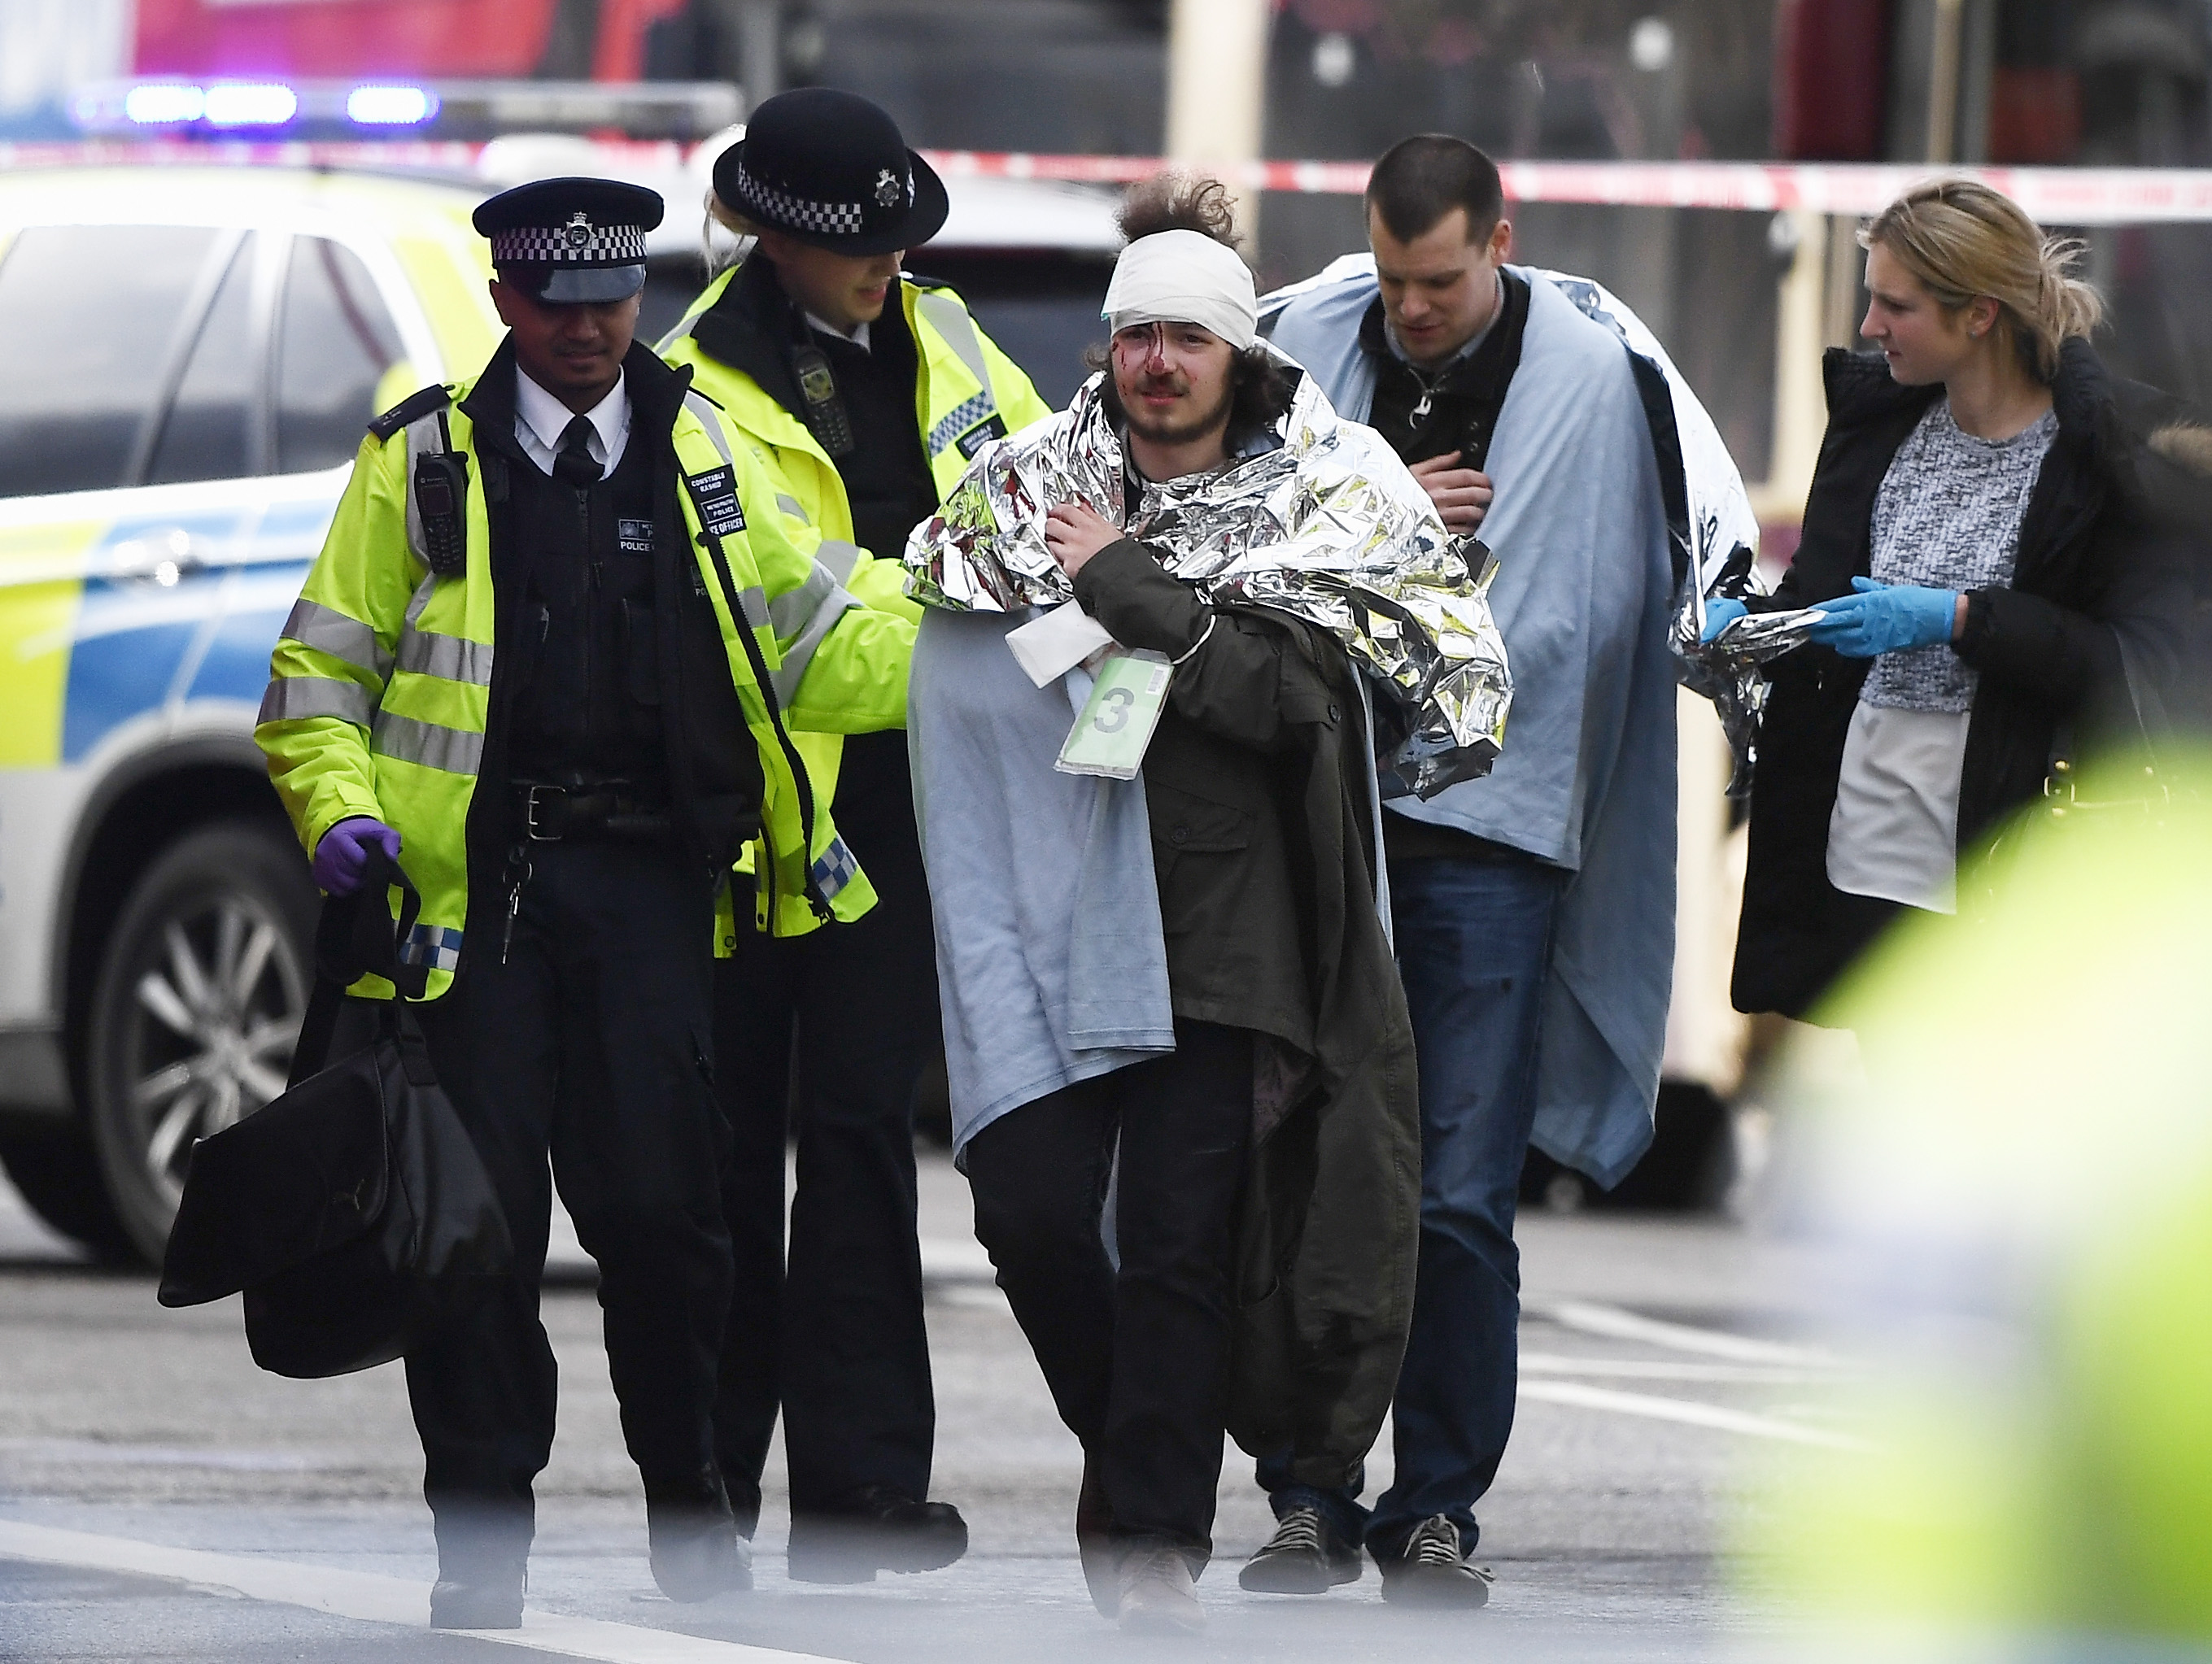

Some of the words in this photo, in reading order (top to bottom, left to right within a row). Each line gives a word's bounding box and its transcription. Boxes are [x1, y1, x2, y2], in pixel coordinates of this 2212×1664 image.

[691, 472, 726, 487] CONSTABLE
[713, 506, 734, 517] POLICE
[718, 517, 744, 533] OFFICER
[620, 541, 650, 551] POLICE
[1093, 686, 1136, 734] 3
